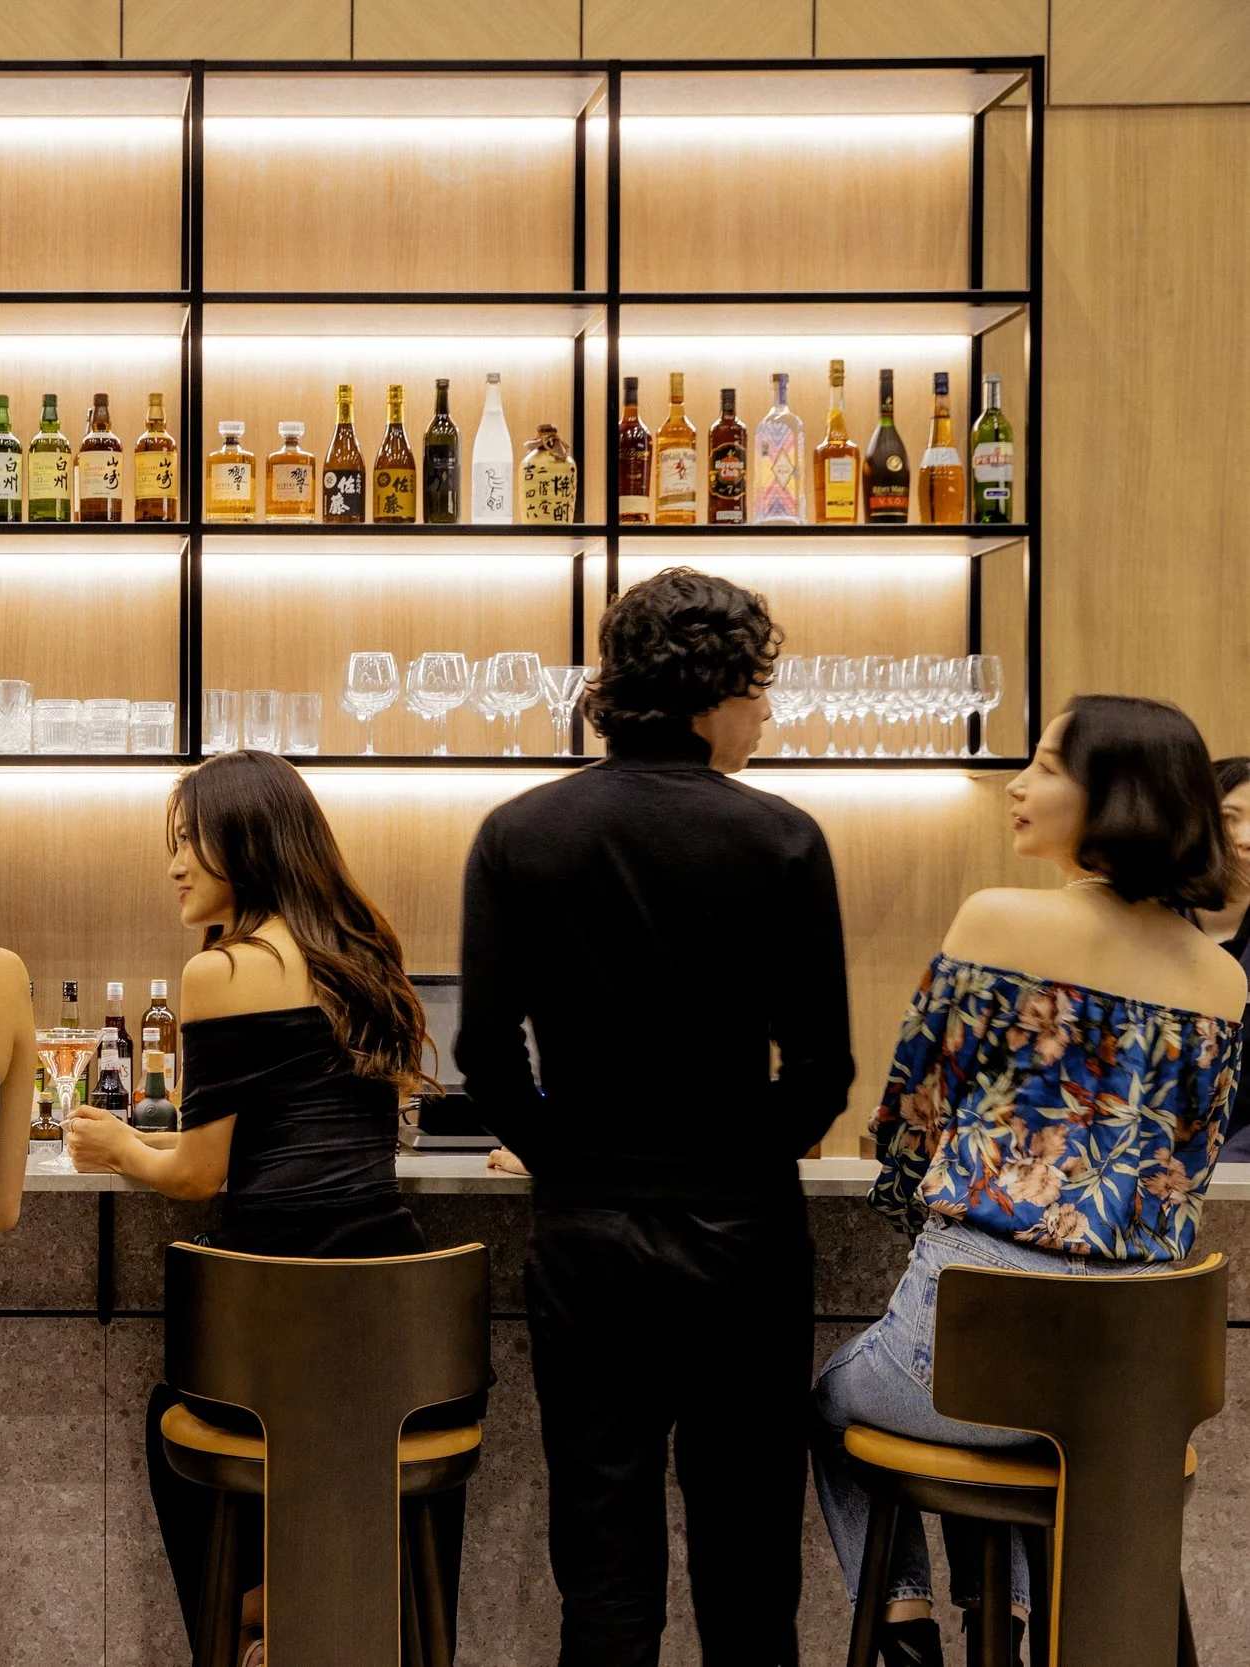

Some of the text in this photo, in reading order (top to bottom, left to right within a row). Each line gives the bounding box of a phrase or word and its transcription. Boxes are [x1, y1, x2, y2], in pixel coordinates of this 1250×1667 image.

[3, 456, 18, 493] 白州
[53, 456, 68, 491] 白州
[727, 485, 734, 495] 7
